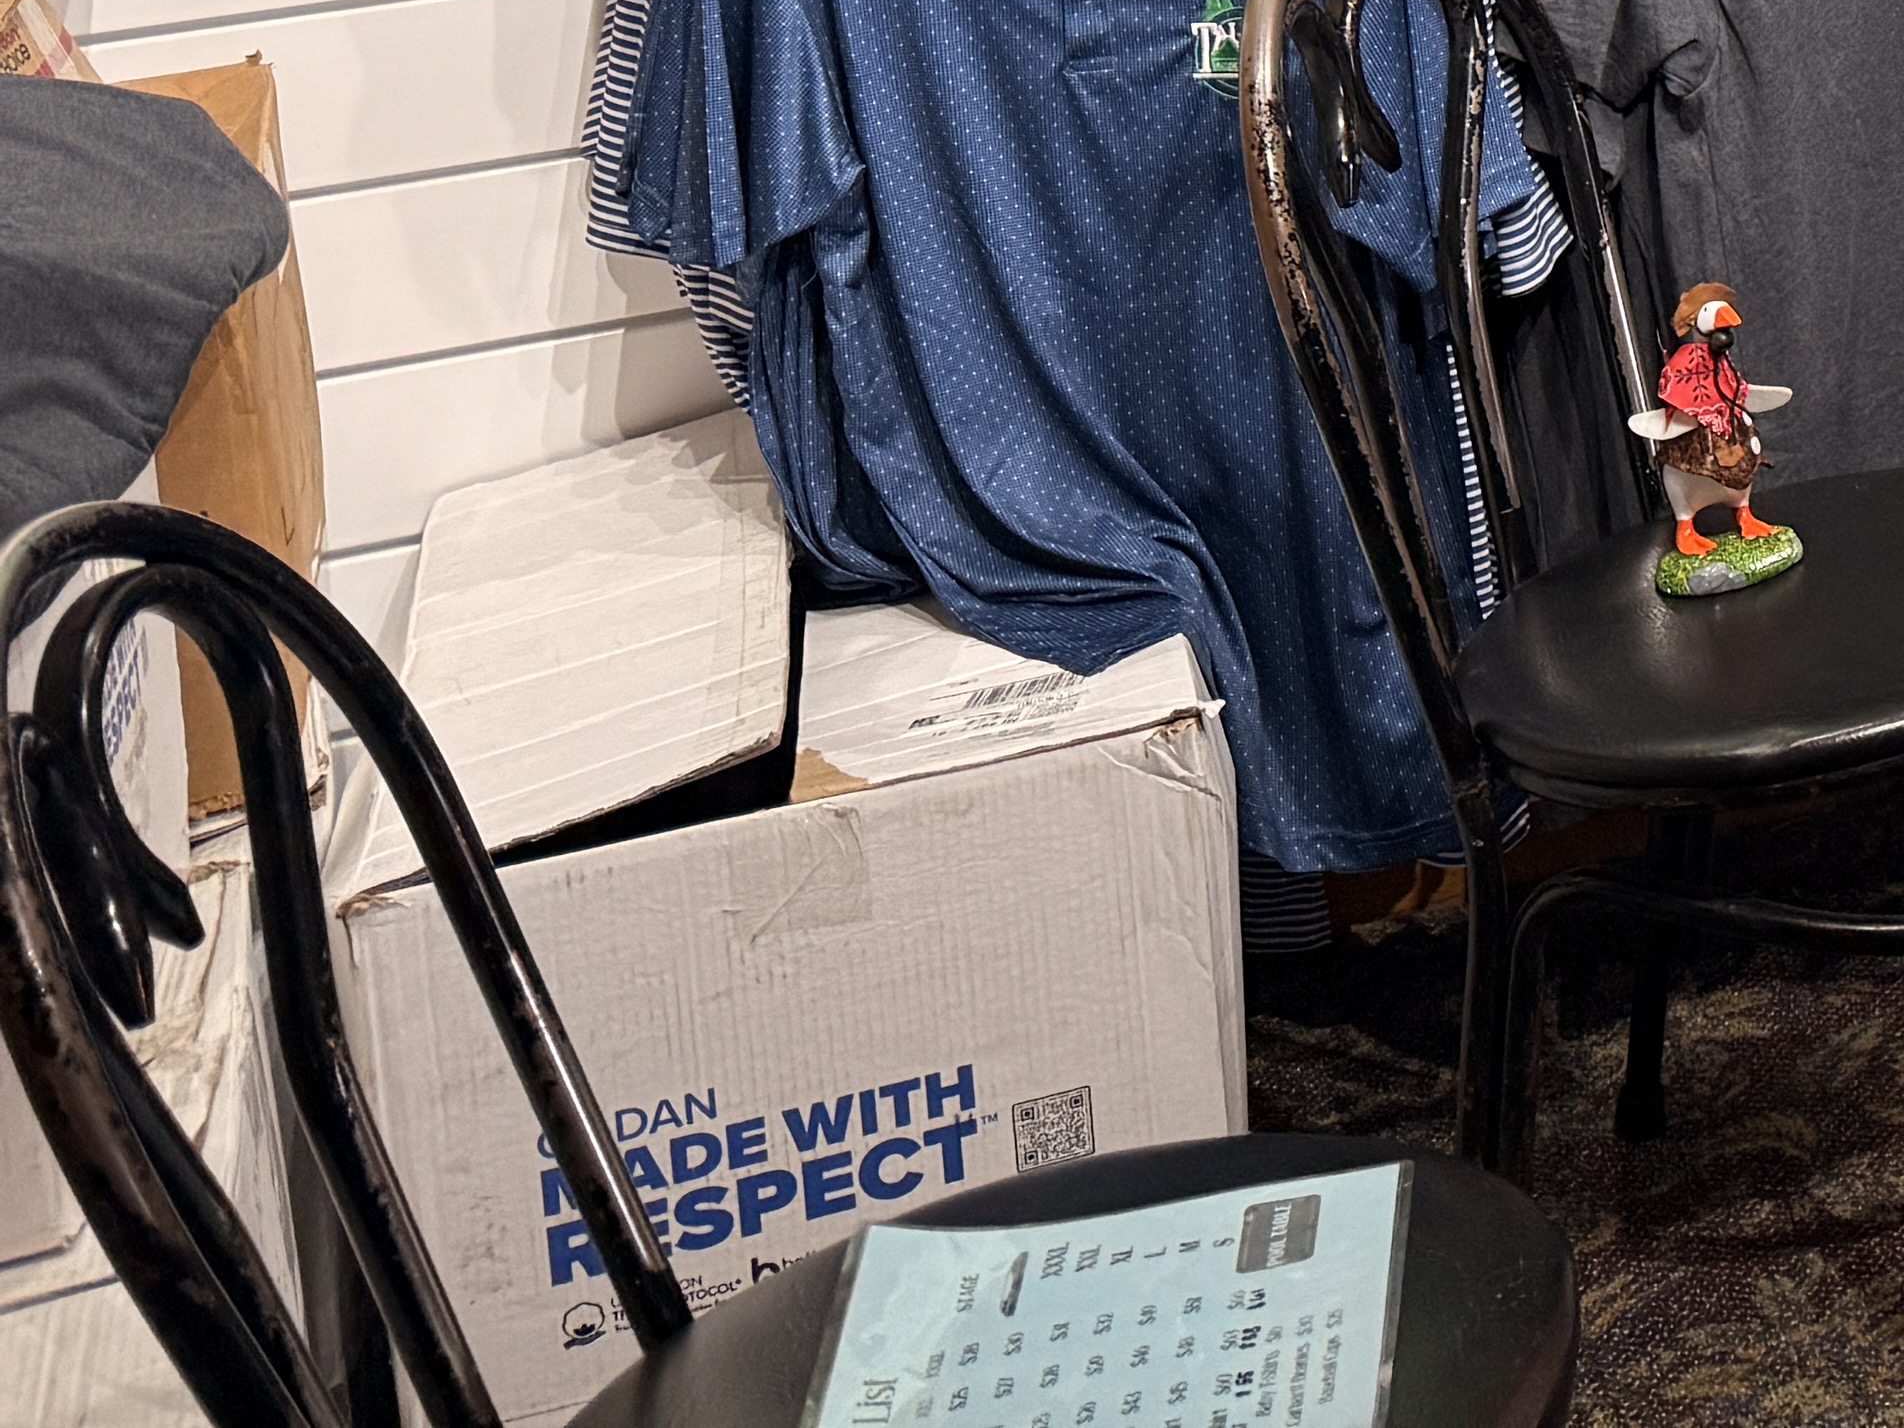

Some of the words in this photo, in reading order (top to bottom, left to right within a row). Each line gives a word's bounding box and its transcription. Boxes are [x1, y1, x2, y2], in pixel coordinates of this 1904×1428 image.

[781, 1064, 977, 1152] WITH
[1270, 1203, 1292, 1239] TABLE
[1074, 1244, 1102, 1273] XXL
[1109, 1245, 1134, 1267] XL
[1143, 1246, 1168, 1259] L
[1212, 1237, 1236, 1248] S
[1266, 1236, 1288, 1269] POOL
[1040, 1242, 1070, 1280] XXXL
[956, 1273, 980, 1313] STAGE
